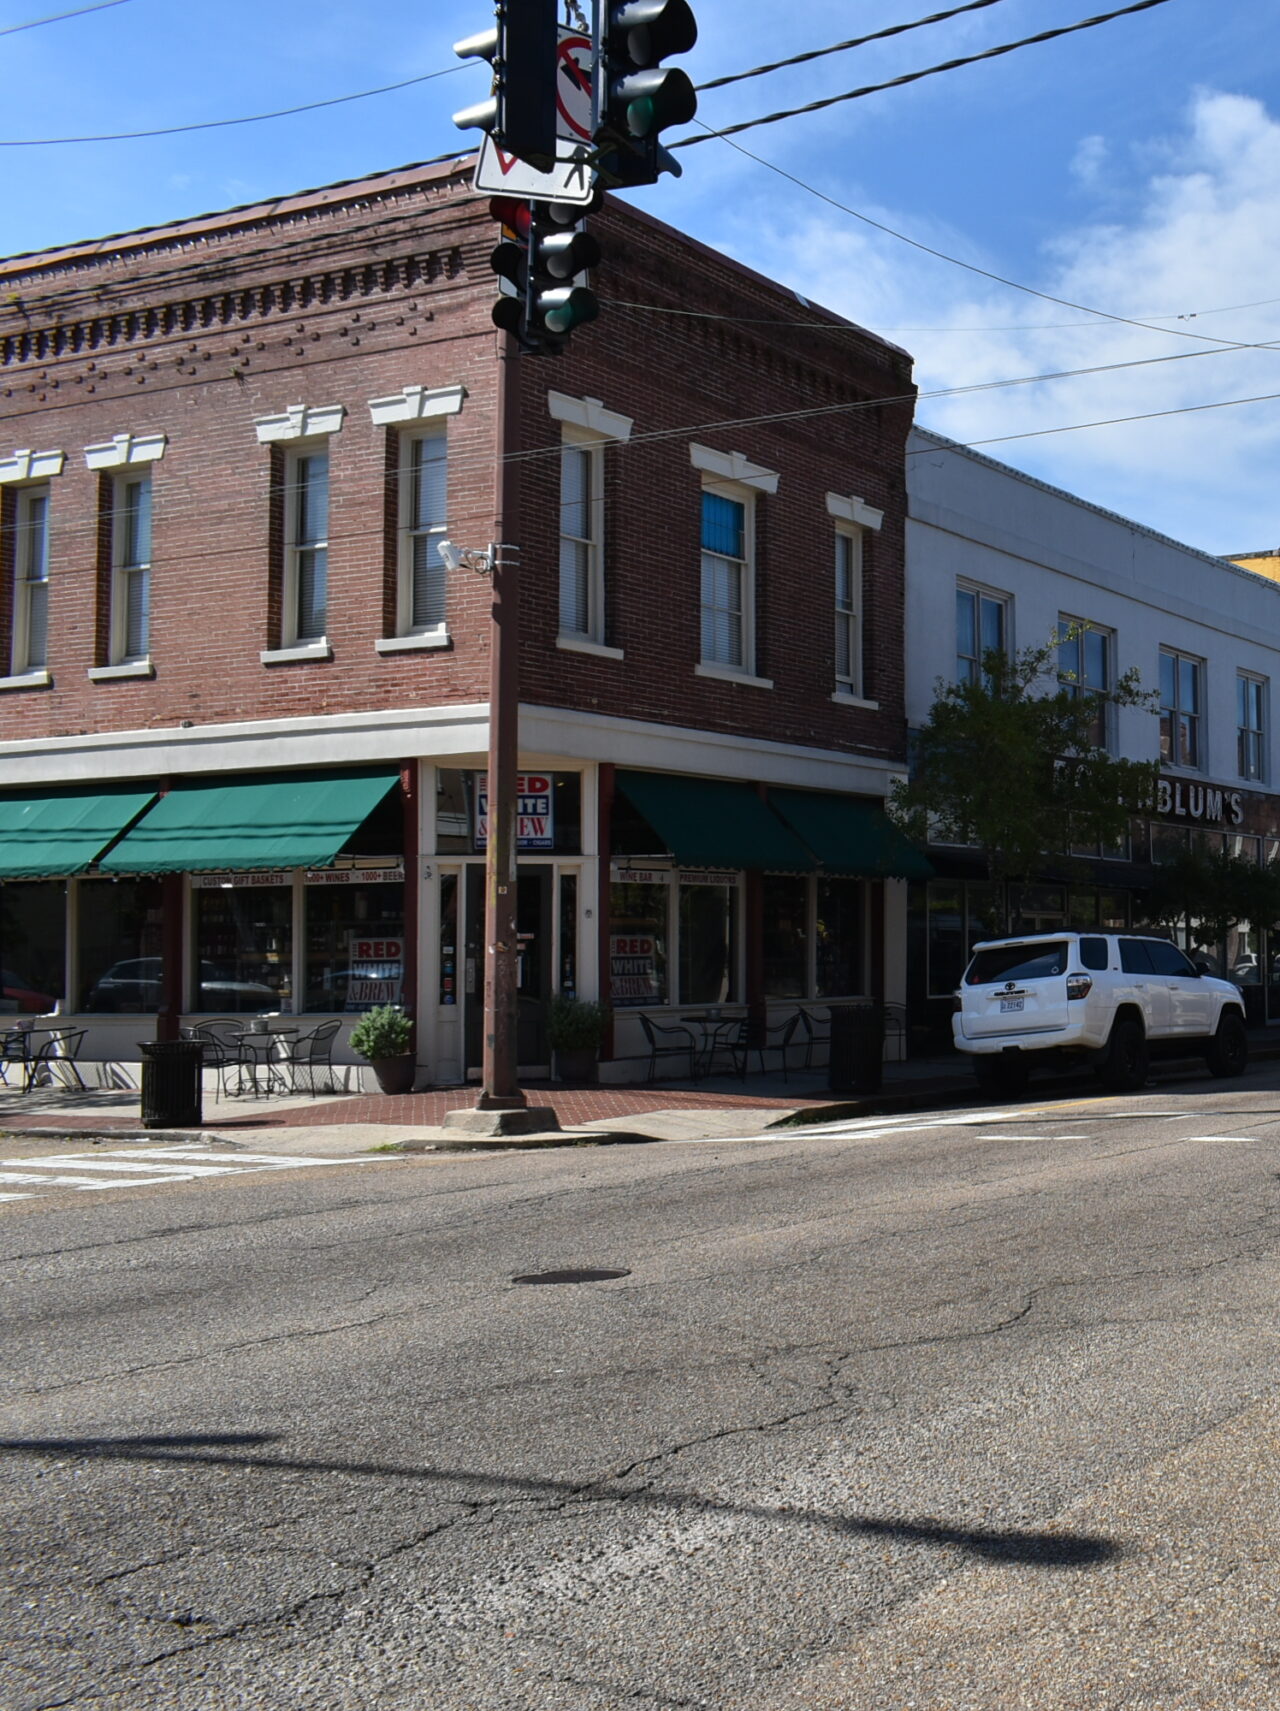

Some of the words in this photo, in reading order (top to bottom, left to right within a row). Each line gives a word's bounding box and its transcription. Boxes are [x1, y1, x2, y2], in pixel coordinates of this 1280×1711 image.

[233, 874, 250, 885] GIFT
[251, 873, 284, 885] BASKETS
[326, 871, 350, 882] WINES
[620, 871, 637, 882] WINE
[639, 873, 653, 882] BAR
[358, 941, 402, 958] RED
[616, 938, 653, 954] RED
[353, 963, 401, 978] WHITE
[612, 959, 653, 974] WHITE
